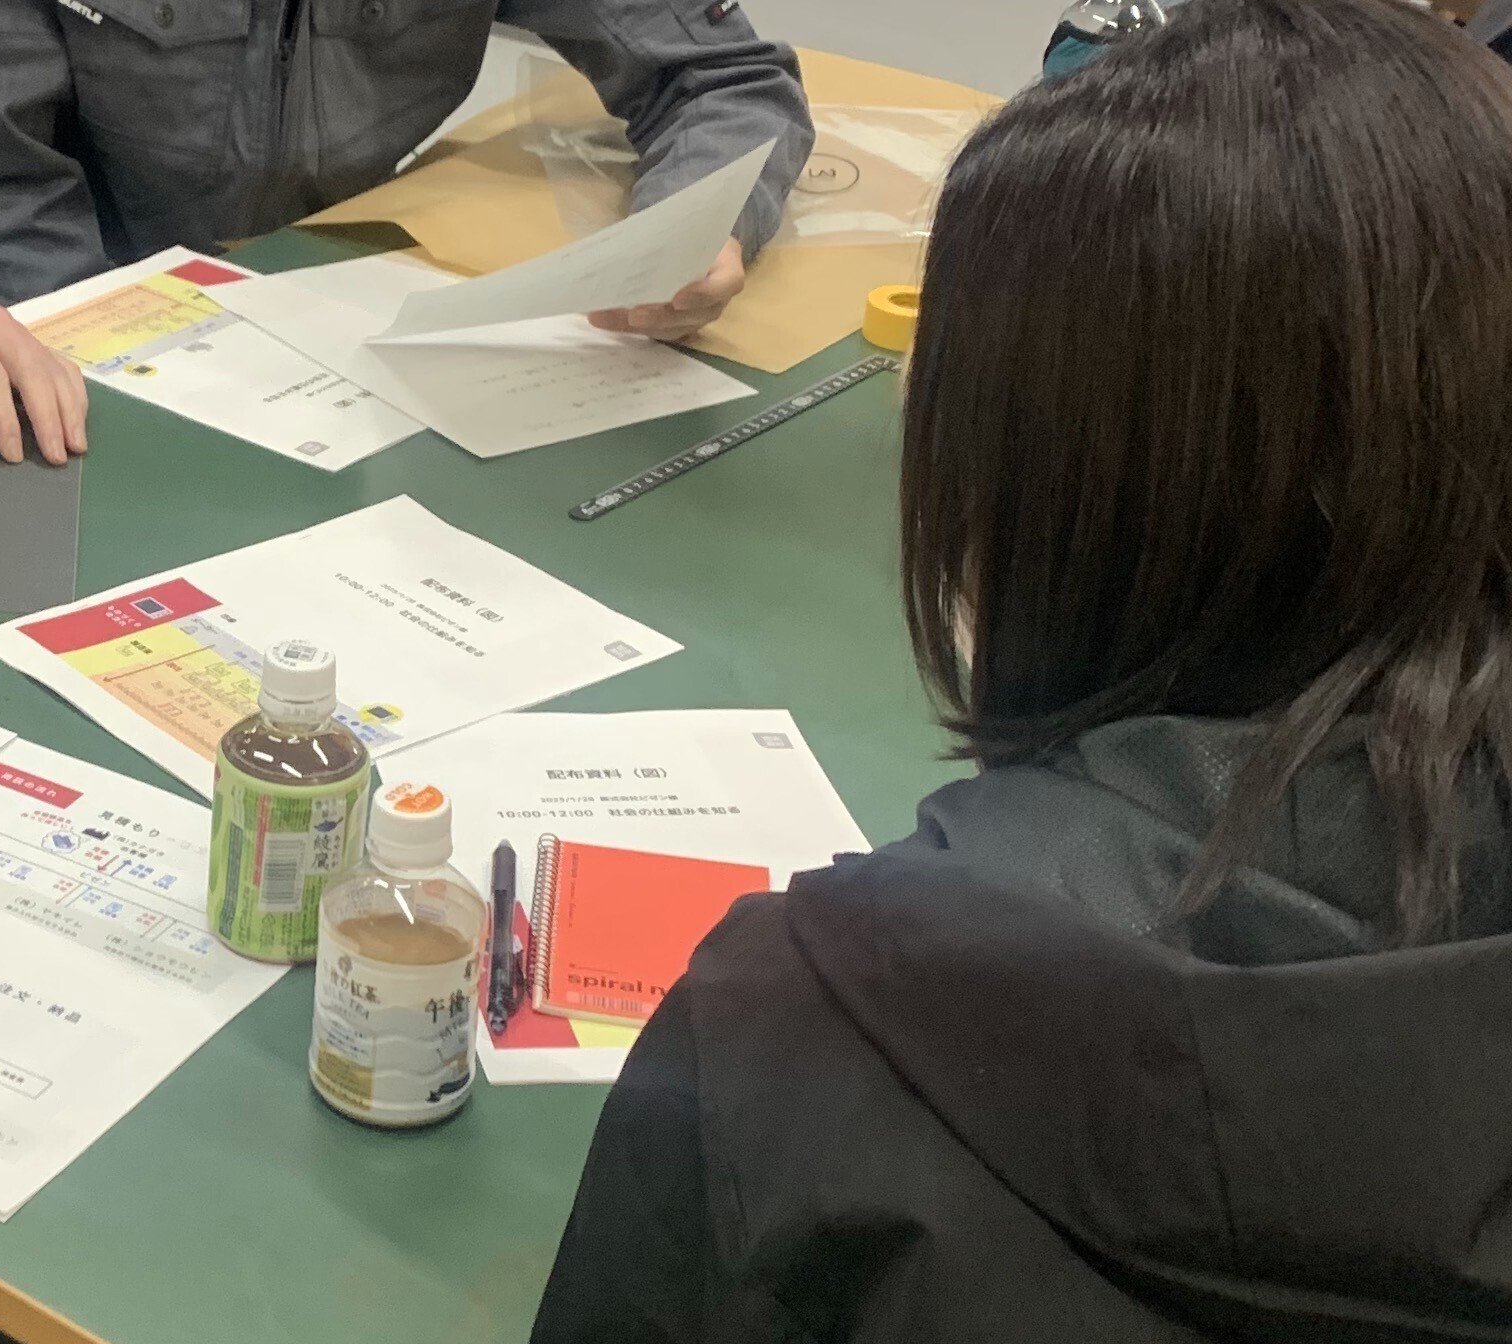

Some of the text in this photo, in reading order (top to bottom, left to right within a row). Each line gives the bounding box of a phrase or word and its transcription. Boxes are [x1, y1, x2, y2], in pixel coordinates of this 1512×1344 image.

[545, 767, 668, 780] 配布資料（図）
[496, 806, 742, 819] 10:00-12:00 社会の仕組みを知る
[567, 973, 643, 994] spiral
